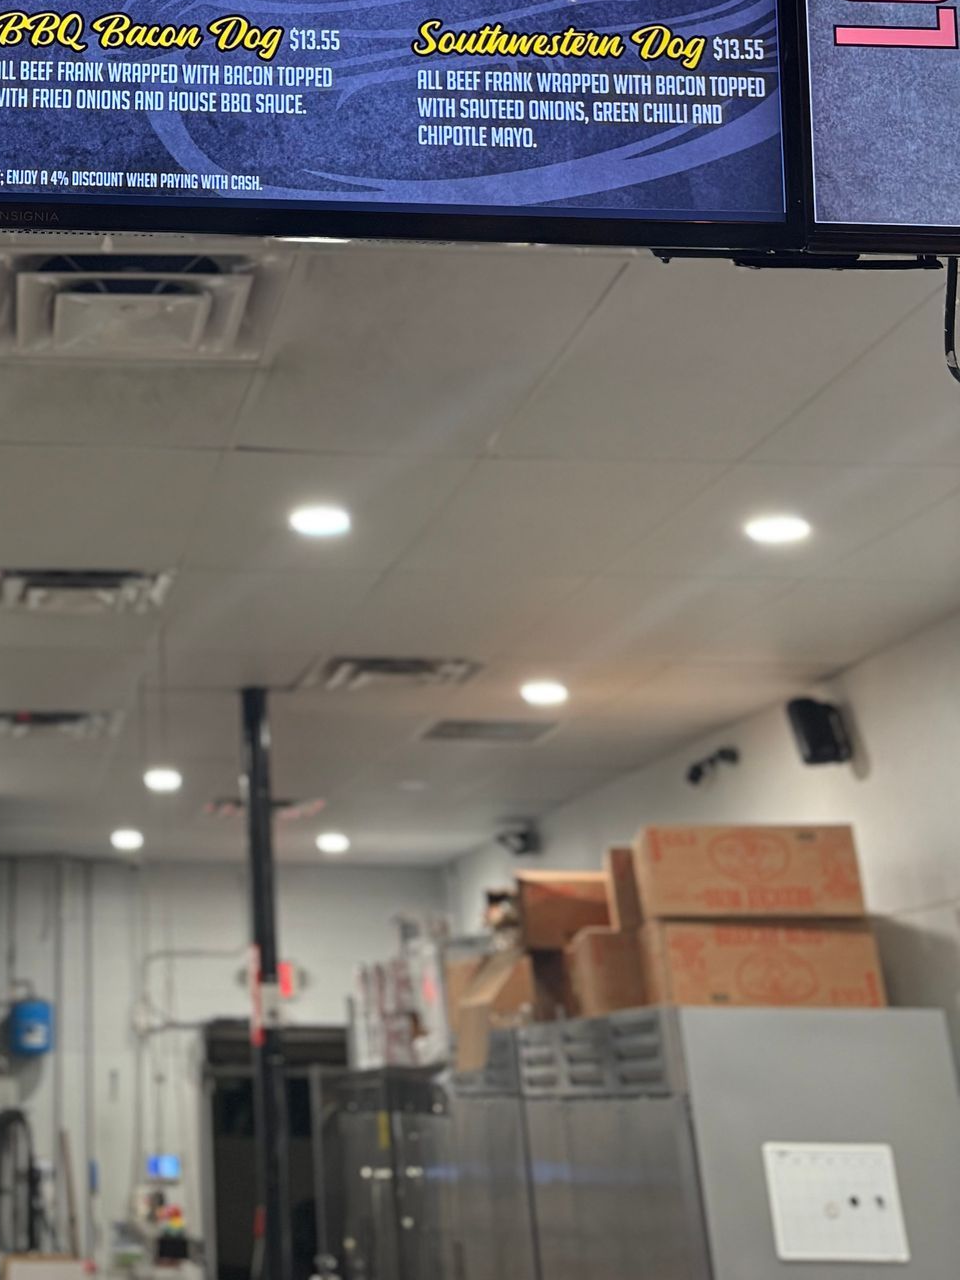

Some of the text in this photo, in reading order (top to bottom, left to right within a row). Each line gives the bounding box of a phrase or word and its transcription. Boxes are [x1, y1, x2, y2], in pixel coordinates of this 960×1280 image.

[413, 21, 764, 69] Southwestern Dog $13.55
[418, 124, 538, 148] CHIPOTLE MAYO.
[6, 169, 38, 185] ENJOY
[40, 170, 48, 185] A
[50, 170, 69, 186] 4%
[72, 170, 124, 187] DISCOUNT
[126, 172, 158, 188] WHEN
[160, 173, 199, 189] PAYING
[200, 174, 229, 190] WITH
[230, 174, 264, 191] CASH.
